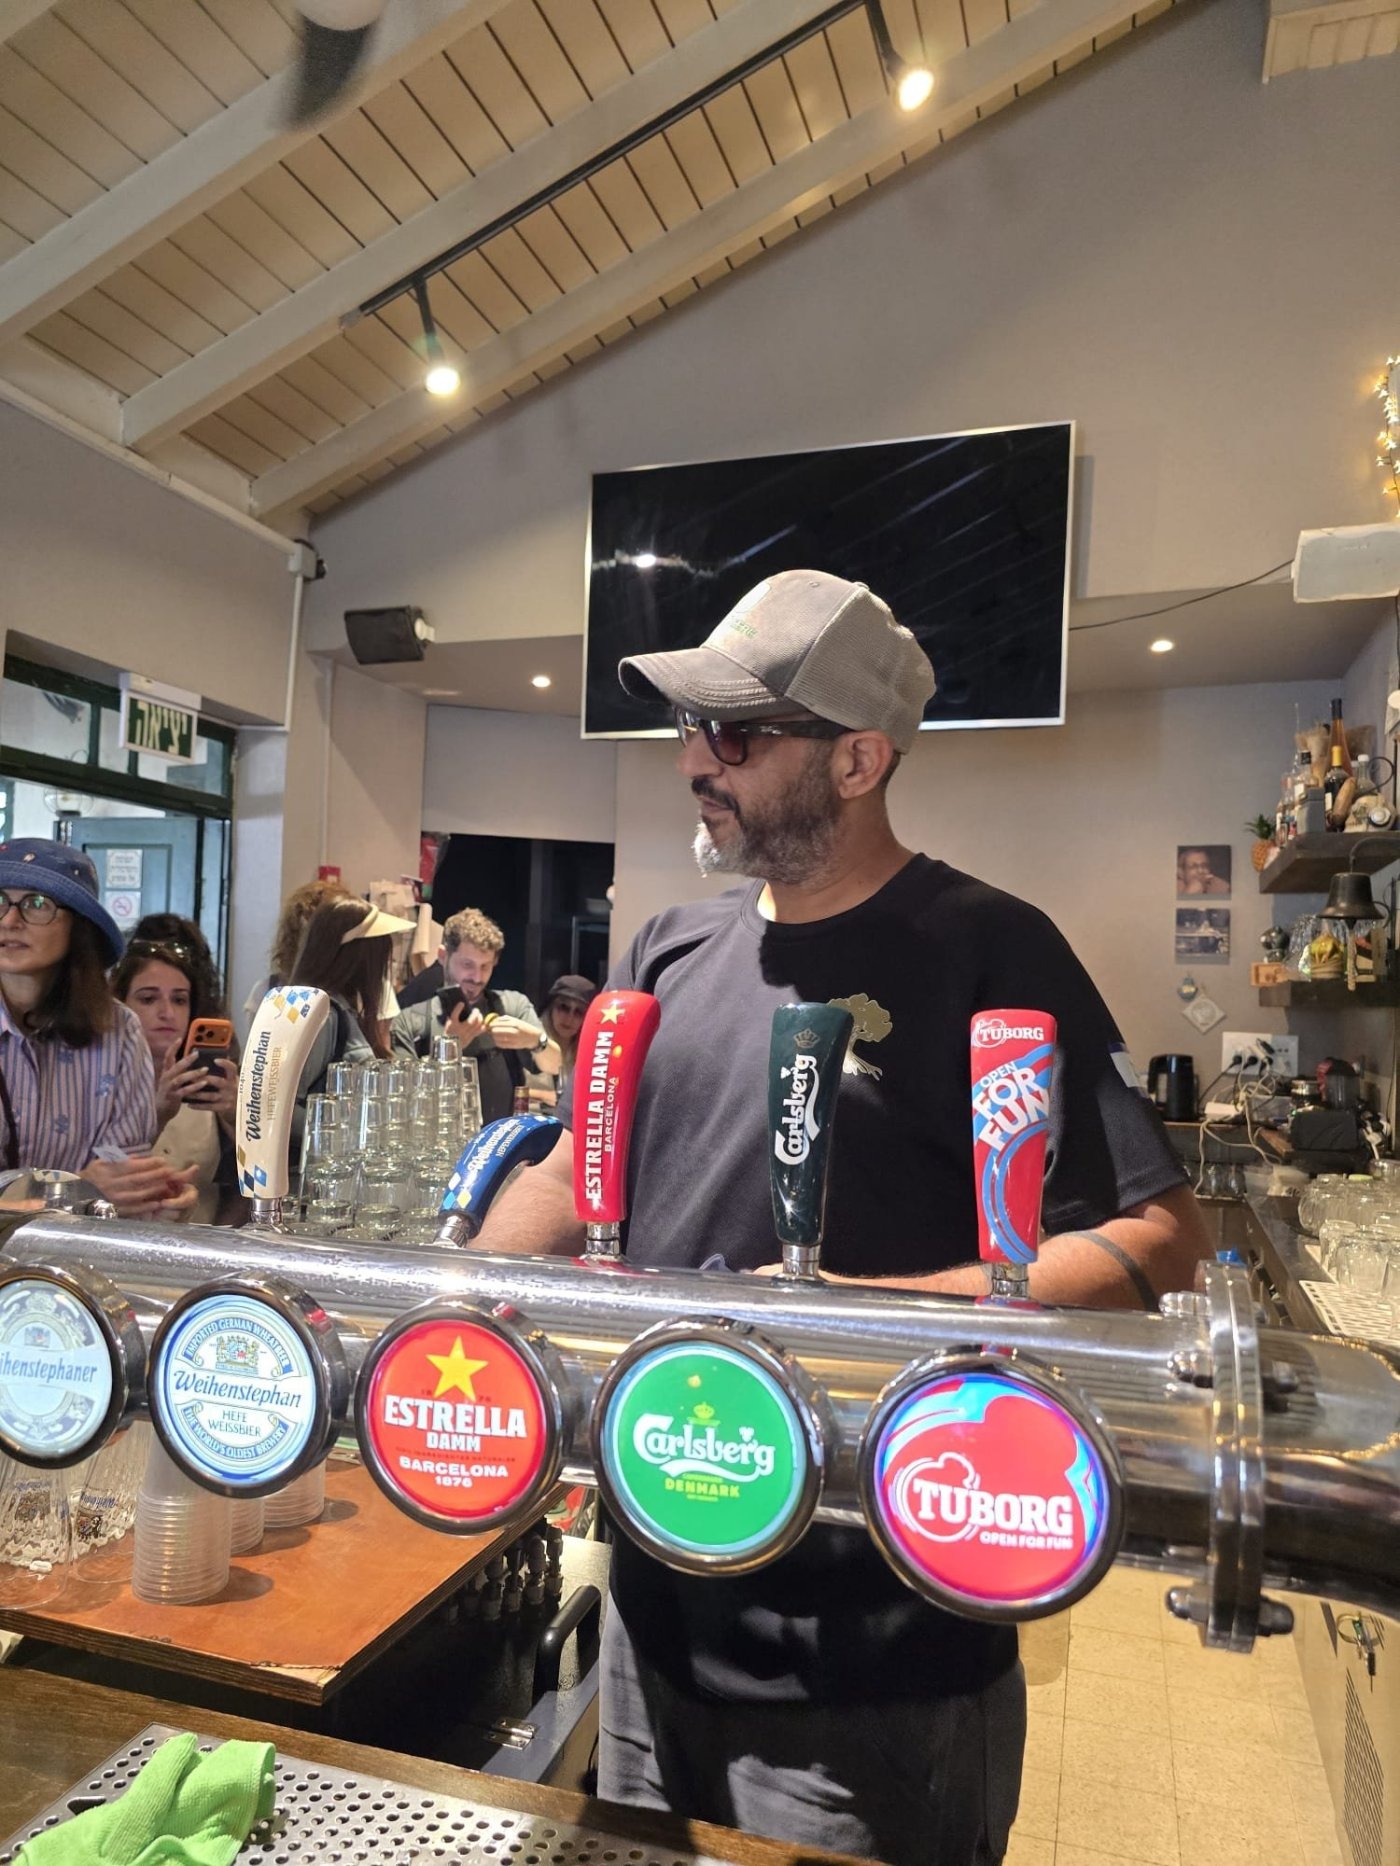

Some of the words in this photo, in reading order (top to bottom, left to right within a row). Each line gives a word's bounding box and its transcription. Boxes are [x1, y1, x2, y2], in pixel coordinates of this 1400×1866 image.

[136, 700, 188, 755] יציאה
[979, 1026, 1045, 1041] TUBORG
[589, 1031, 615, 1094] DAMM
[979, 1061, 1018, 1088] OPEN
[245, 1030, 271, 1142] Weihenstephan
[972, 1067, 1039, 1120] FOR
[604, 1076, 618, 1152] BARCELONA
[774, 1053, 821, 1166] Carlsberg
[978, 1087, 1050, 1152] FUN
[585, 1098, 605, 1201] ESTRELLA
[186, 1320, 219, 1355] IMPORTED
[218, 1317, 253, 1332] GERMAN
[252, 1322, 279, 1351] WHEAT
[173, 1369, 302, 1408] Weihenstephan
[208, 1418, 261, 1437] WEISSBIER
[222, 1409, 248, 1423] HEFE
[384, 1394, 528, 1438] ESTRELLA
[225, 1445, 256, 1459] OLDEST
[426, 1432, 481, 1453] DAMM
[632, 1413, 776, 1483] Carlsberg
[399, 1455, 508, 1477] BARCELONA
[435, 1475, 473, 1488] 1876
[664, 1477, 741, 1498] DENMARK
[912, 1478, 1074, 1536] TUBORG
[979, 1531, 1018, 1548] OPEN
[1018, 1534, 1046, 1549] FOR
[1046, 1536, 1074, 1550] FUN
